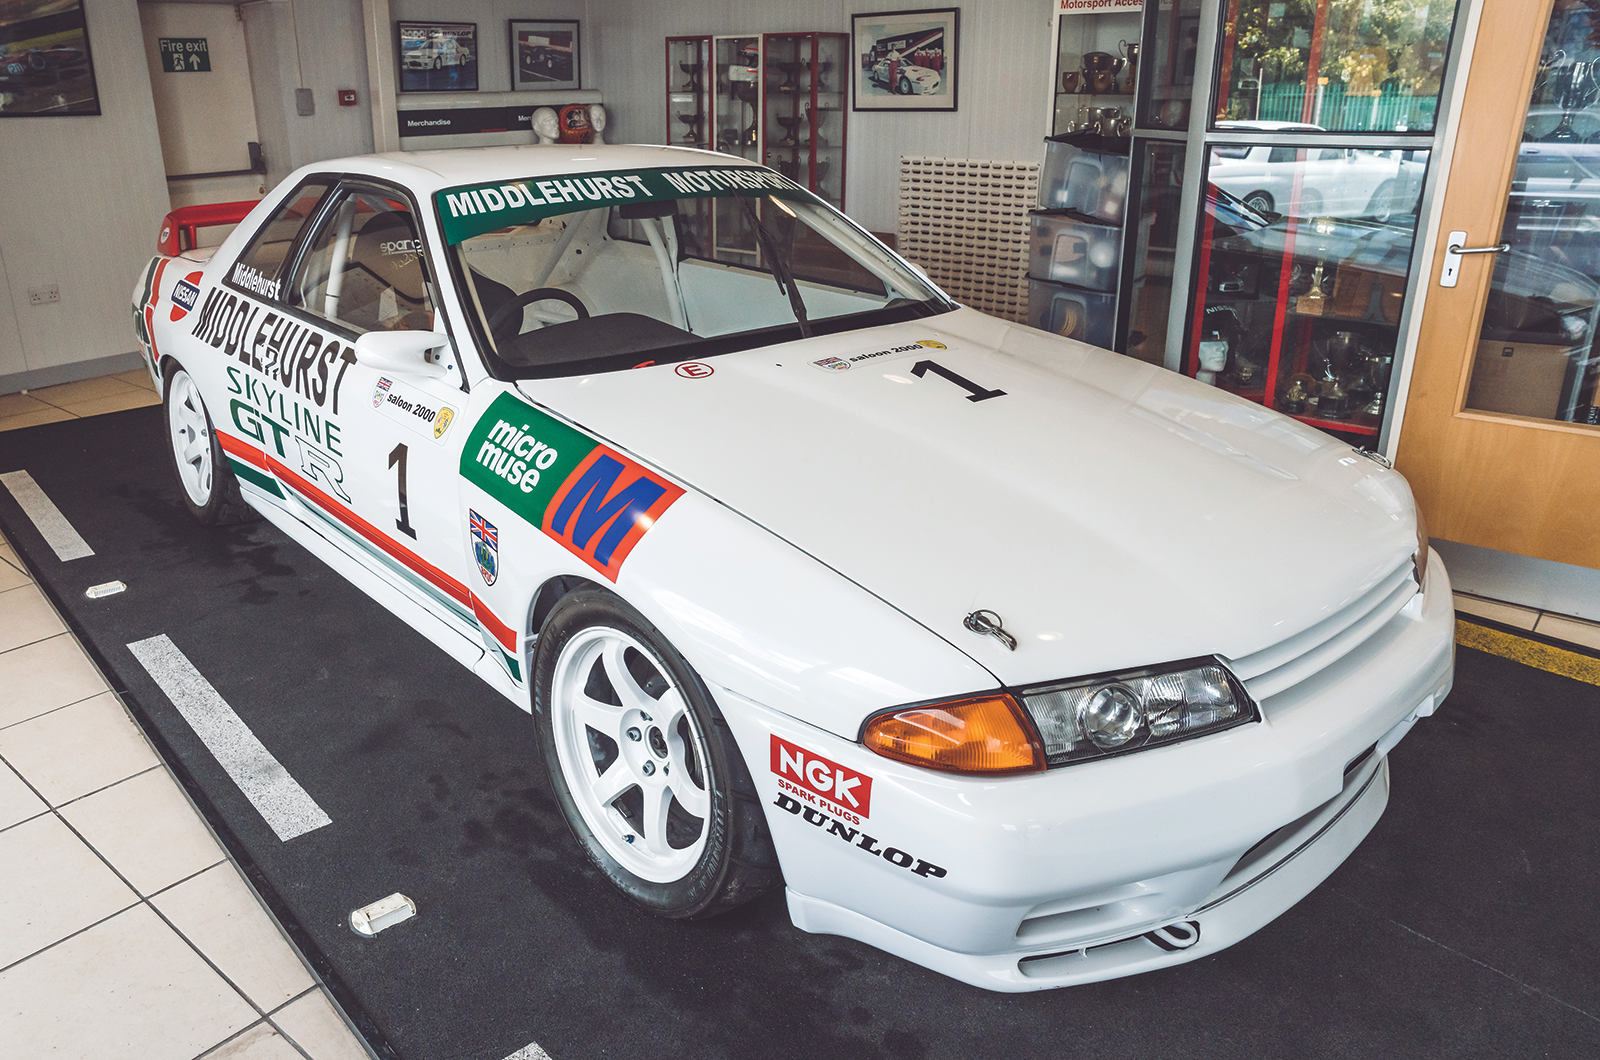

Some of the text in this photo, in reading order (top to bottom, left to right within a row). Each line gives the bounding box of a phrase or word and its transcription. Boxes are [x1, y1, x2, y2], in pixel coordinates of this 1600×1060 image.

[1060, 0, 1112, 10] Motorsport
[160, 40, 207, 52] Fire exit
[407, 118, 451, 127] Merchandise
[446, 169, 801, 217] MIDDLEHURST MOTORSPORT
[380, 239, 422, 255] sparc
[173, 283, 198, 307] NISSAN
[231, 262, 281, 301] Middlehurst
[191, 286, 358, 416] MIDDLEHURST
[683, 364, 708, 377] E
[849, 350, 891, 363] saloon
[891, 343, 924, 354] 2000
[910, 359, 1008, 403] 1
[226, 365, 343, 458] SKYLINE
[387, 393, 436, 423] saloon 2000
[475, 439, 541, 494] muse
[487, 418, 558, 471] micro
[388, 442, 417, 541] 1
[551, 453, 668, 567] M
[780, 743, 862, 809] NGK
[778, 778, 860, 826] SPARK PLUGS
[773, 791, 948, 879] DUNLOP
